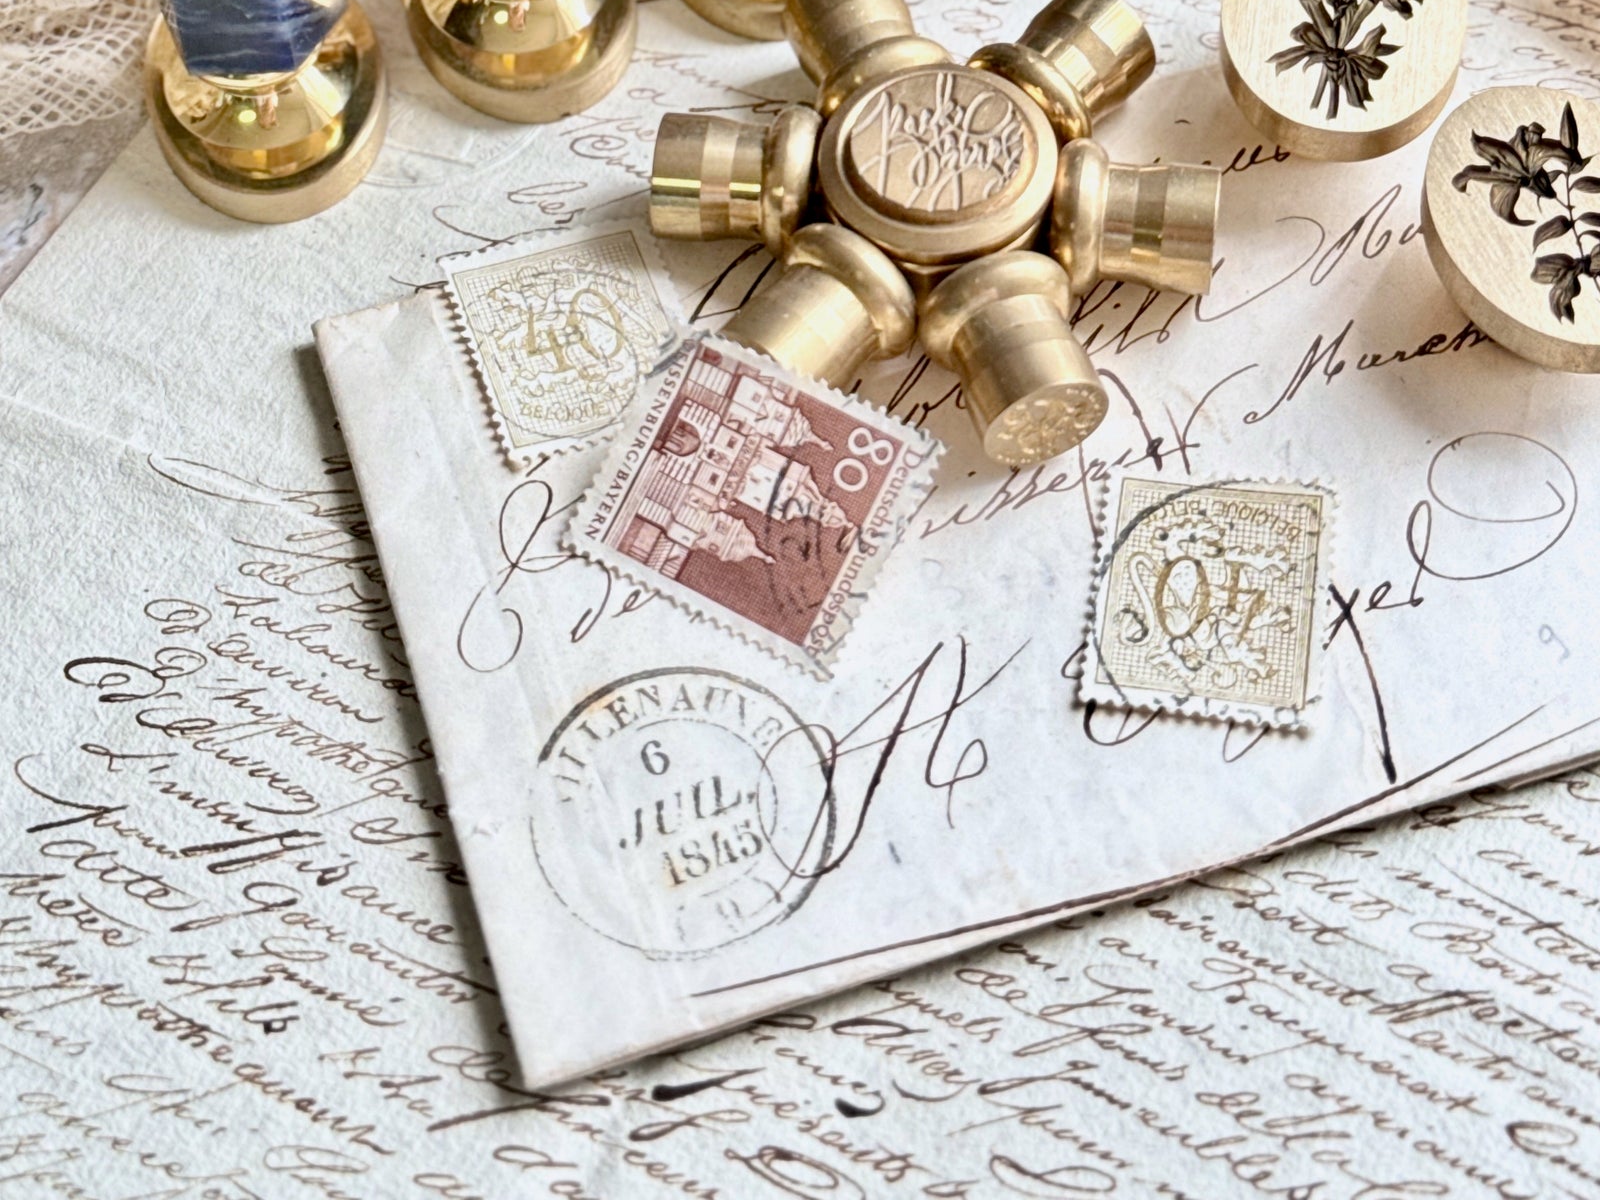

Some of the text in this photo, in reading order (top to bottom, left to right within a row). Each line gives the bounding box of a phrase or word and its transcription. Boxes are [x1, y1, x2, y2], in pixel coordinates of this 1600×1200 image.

[833, 426, 895, 493] 80
[866, 444, 924, 539] Deutsche
[640, 739, 671, 776] 6
[662, 818, 763, 888] 1845
